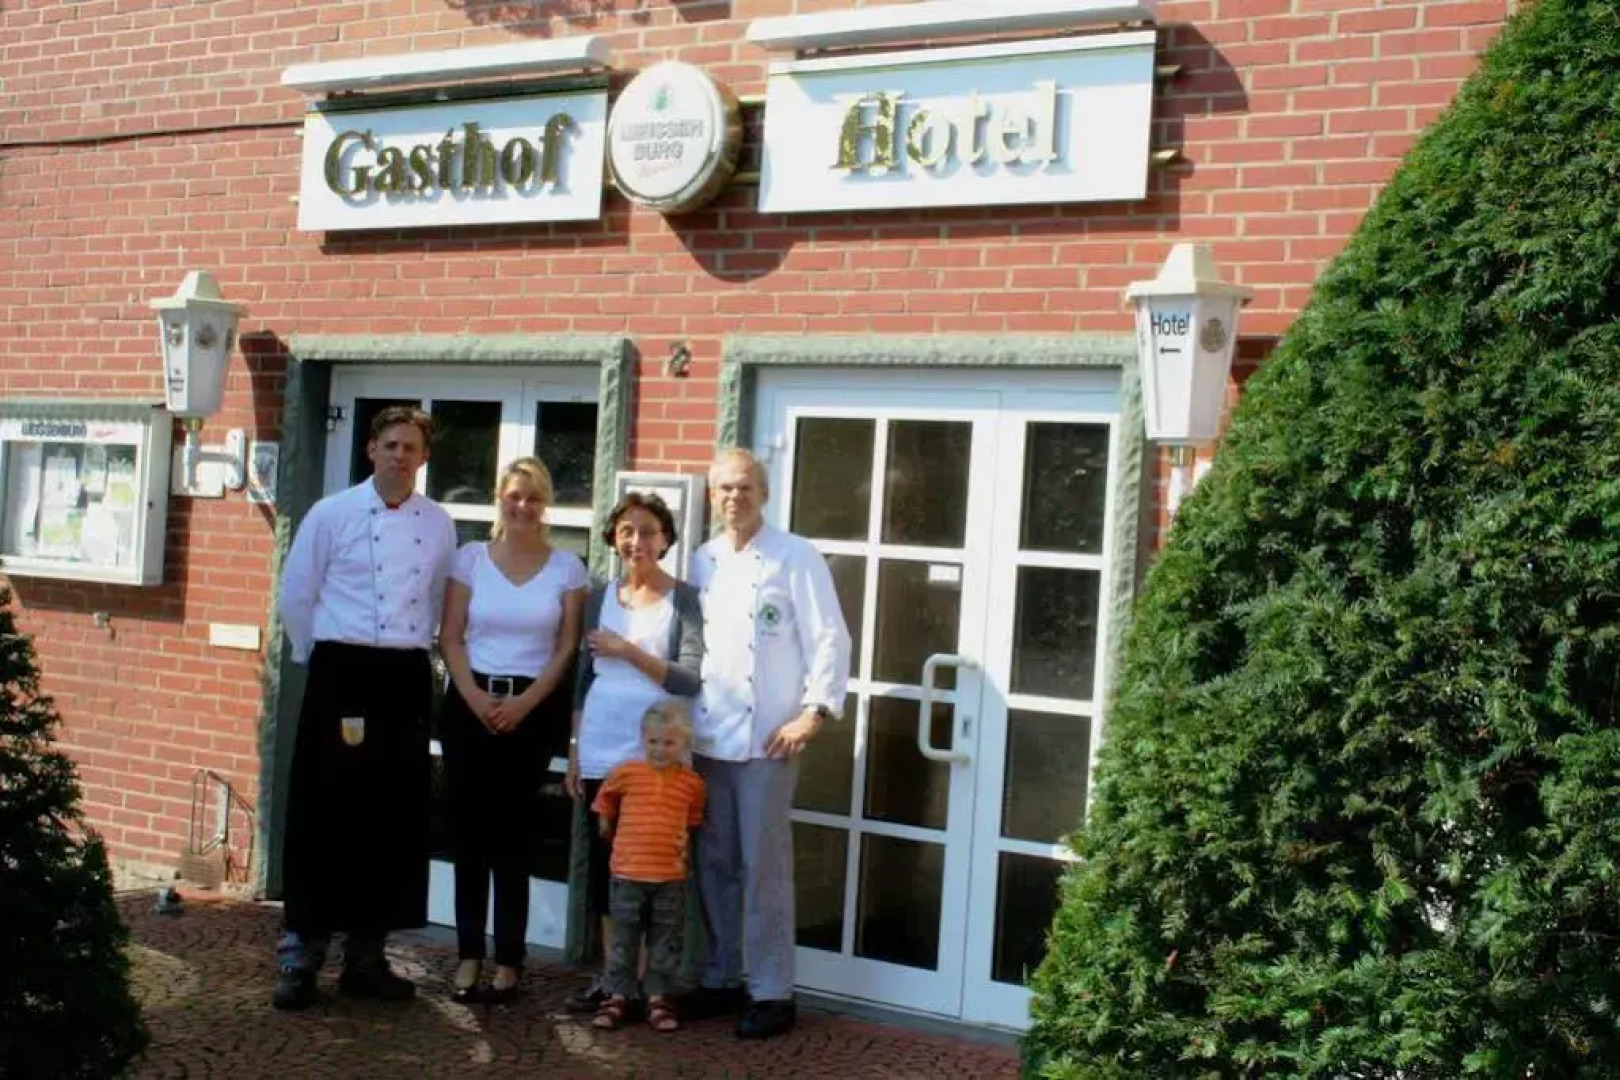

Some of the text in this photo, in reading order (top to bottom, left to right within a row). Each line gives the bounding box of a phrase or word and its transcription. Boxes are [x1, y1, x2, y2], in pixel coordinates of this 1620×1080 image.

[325, 112, 576, 197] Gasthof
[830, 79, 1057, 174] Hotel
[1150, 311, 1190, 336] Hotel
